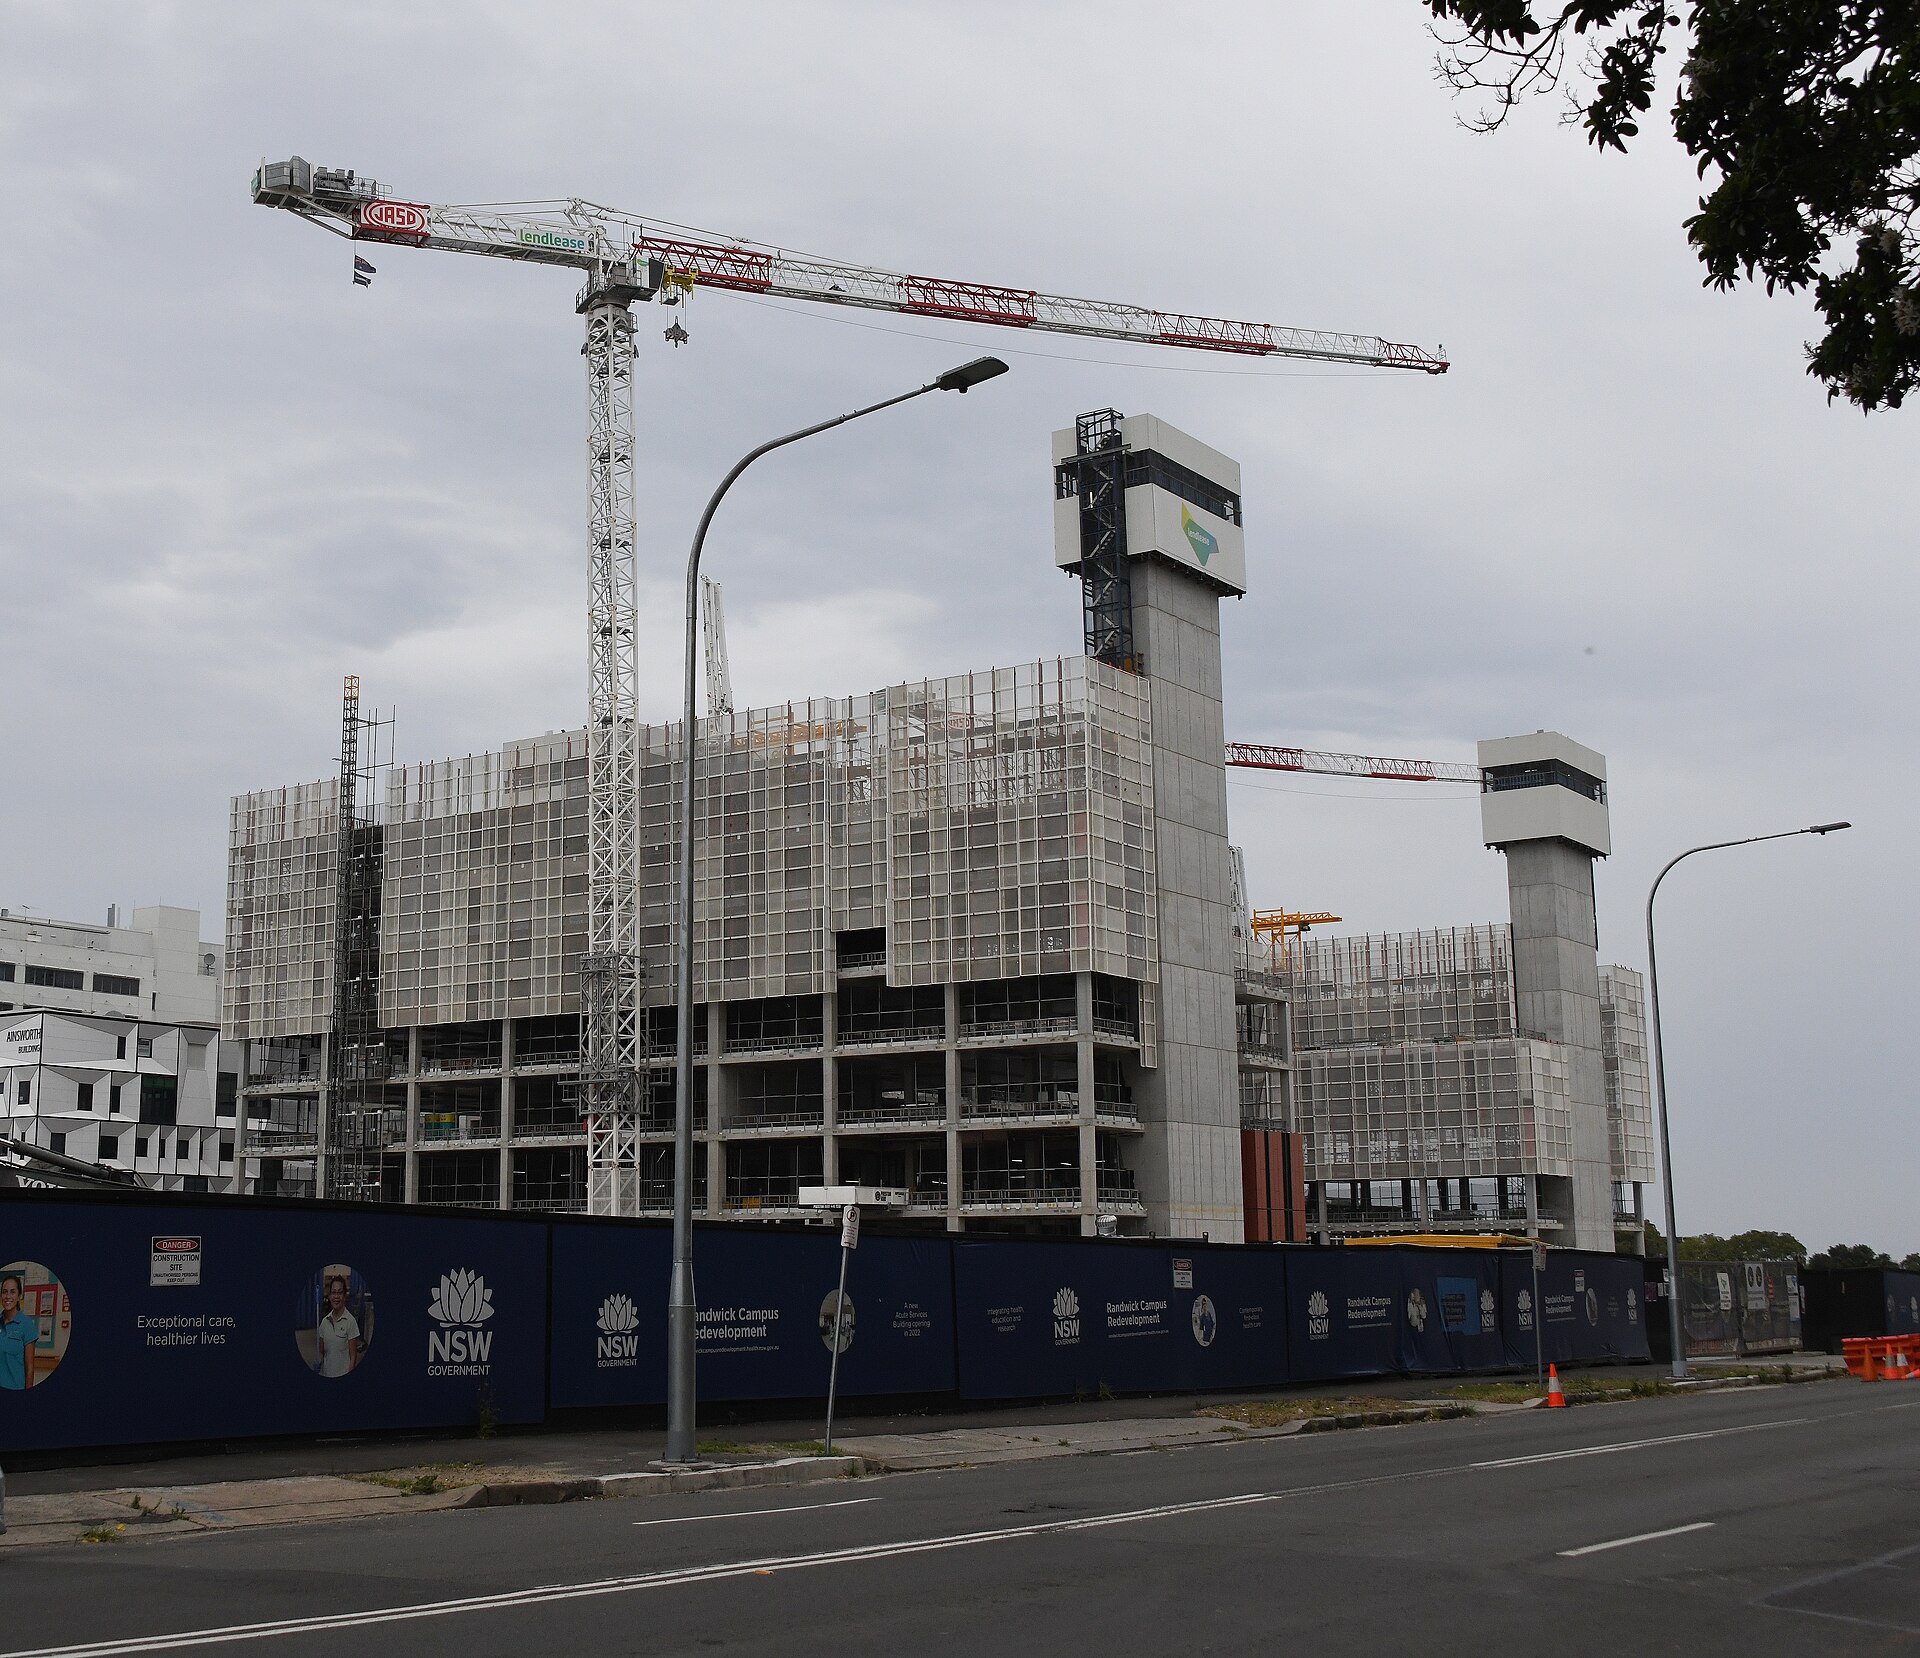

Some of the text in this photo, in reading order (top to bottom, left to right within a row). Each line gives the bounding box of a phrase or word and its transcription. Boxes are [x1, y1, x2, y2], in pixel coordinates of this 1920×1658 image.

[520, 229, 585, 249] lendlease
[6, 1028, 42, 1042] AINSWORTH
[18, 1044, 40, 1054] BUILDING
[162, 1241, 191, 1249] DANGER
[153, 1254, 200, 1262] CONSTRUCTION
[1106, 1300, 1168, 1313] Randwick Campus
[1347, 1296, 1392, 1307] Randwick Campus
[695, 1307, 779, 1322] andwick Campus
[895, 1310, 928, 1319] Acute Services
[987, 1307, 1010, 1316] Integrating
[1347, 1308, 1387, 1320] Redevelopment
[137, 1314, 236, 1330] Exceptional care,
[892, 1320, 931, 1329] Building opening
[991, 1316, 1013, 1324] education
[1107, 1313, 1160, 1327] Redevelopment
[1481, 1314, 1495, 1327] NSW
[1518, 1312, 1533, 1325] NSW
[997, 1325, 1016, 1333] research
[1054, 1318, 1080, 1338] NSW
[1309, 1318, 1329, 1334] NSW
[146, 1331, 226, 1346] healthier lives
[695, 1324, 767, 1341] edevelopment
[909, 1329, 921, 1337] 2022
[428, 1330, 493, 1363] NSW
[597, 1335, 639, 1358] NSW
[1054, 1337, 1080, 1346] GOVERNMENT
[597, 1358, 638, 1368] GOVERNMENT
[427, 1365, 491, 1376] GOVERNMENT
